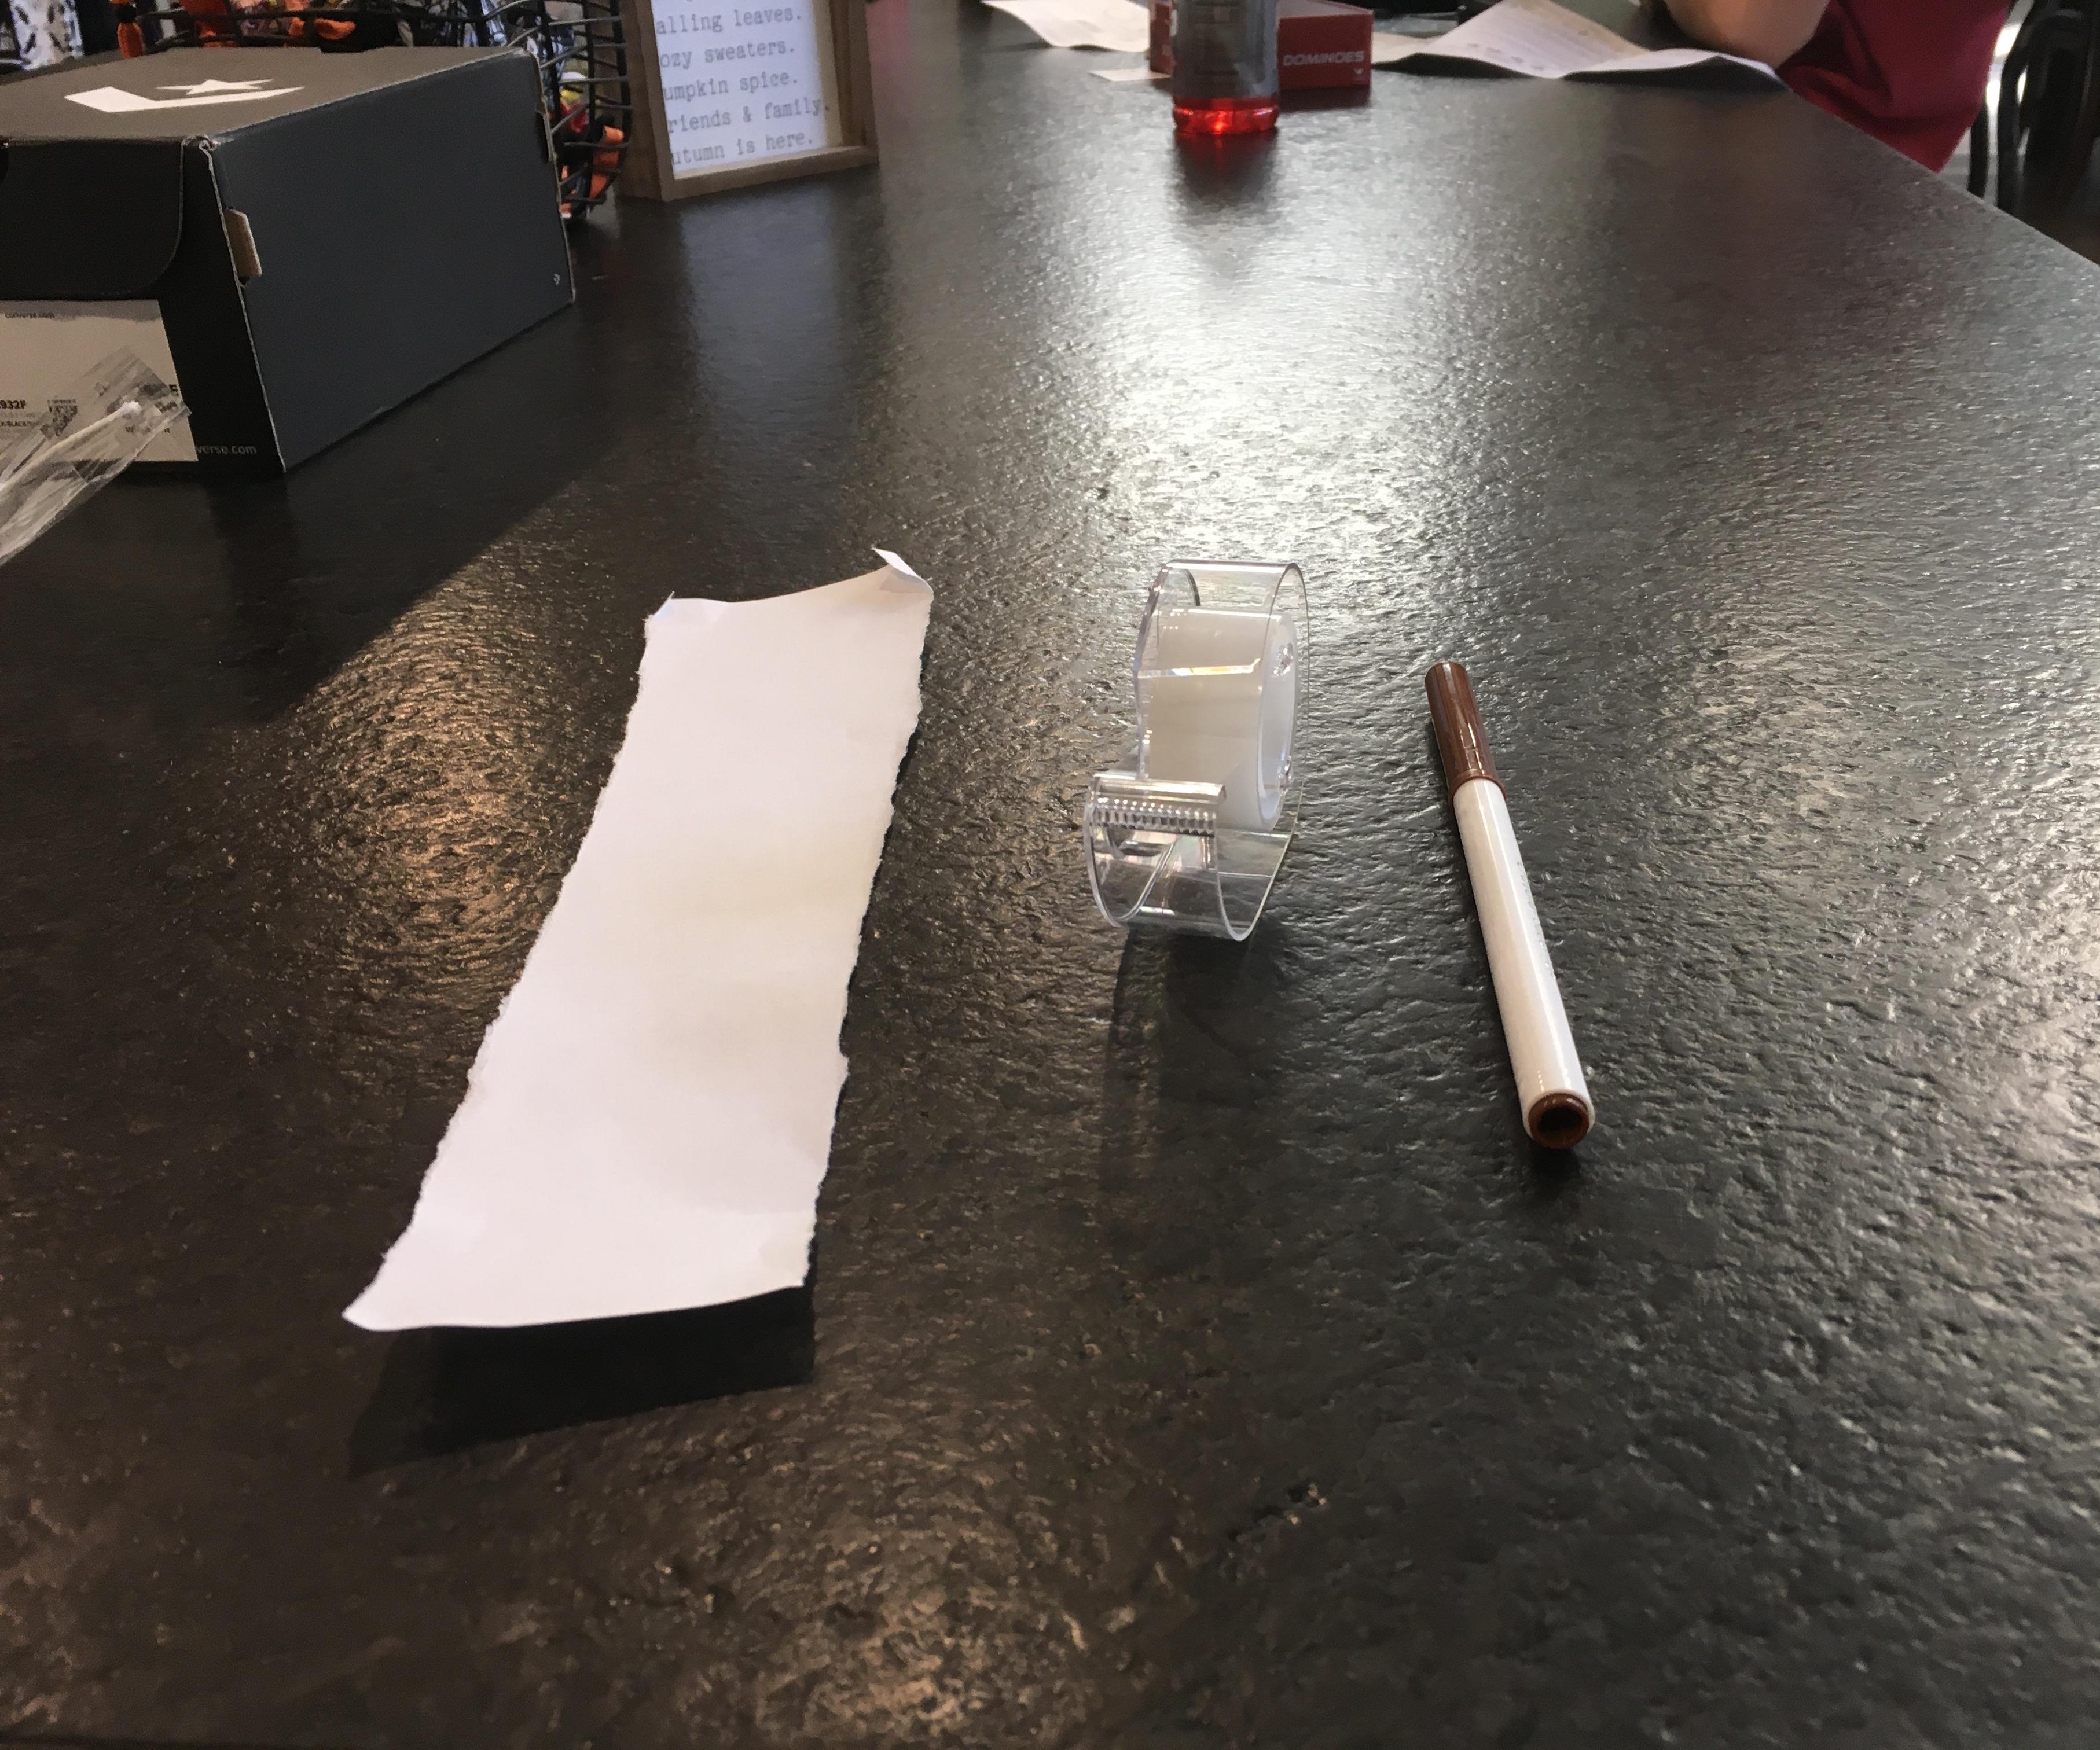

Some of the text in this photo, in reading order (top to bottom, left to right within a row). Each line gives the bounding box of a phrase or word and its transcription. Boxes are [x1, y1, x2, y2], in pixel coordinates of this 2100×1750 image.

[656, 8, 801, 34] alling leaves.
[660, 41, 795, 70] ozy sweaters.
[1283, 51, 1364, 66] DOMINOES
[663, 71, 798, 102] umpkin spice.
[667, 97, 829, 133] riends & family.
[673, 132, 813, 165] utumn is here.
[196, 445, 257, 454] verse.com
